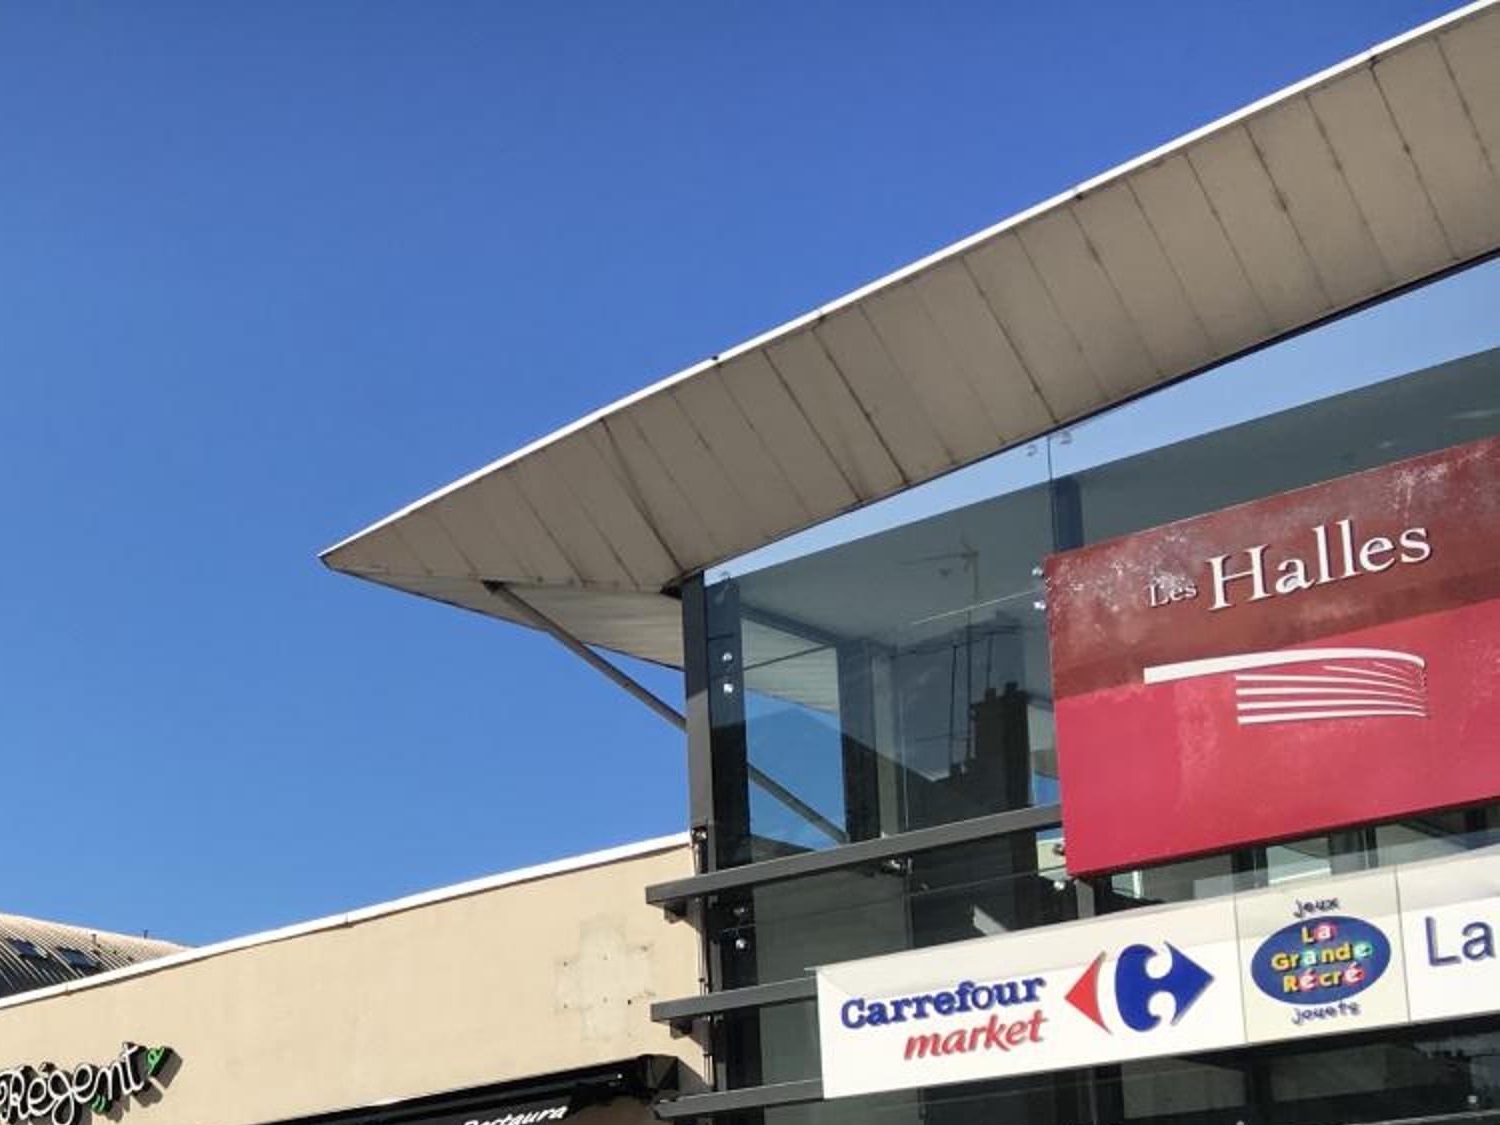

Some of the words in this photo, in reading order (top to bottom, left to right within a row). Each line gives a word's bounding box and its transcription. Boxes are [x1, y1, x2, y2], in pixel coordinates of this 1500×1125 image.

[1148, 582, 1198, 607] Les
[1207, 519, 1433, 611] Halles
[1293, 898, 1341, 918] jeux
[1301, 923, 1337, 945] La
[1425, 916, 1497, 967] La
[1271, 940, 1374, 971] Grande
[1283, 962, 1366, 993] Récré
[840, 977, 1047, 1029] Carrefour
[1291, 1001, 1361, 1026] jouets
[903, 1009, 1049, 1060] market
